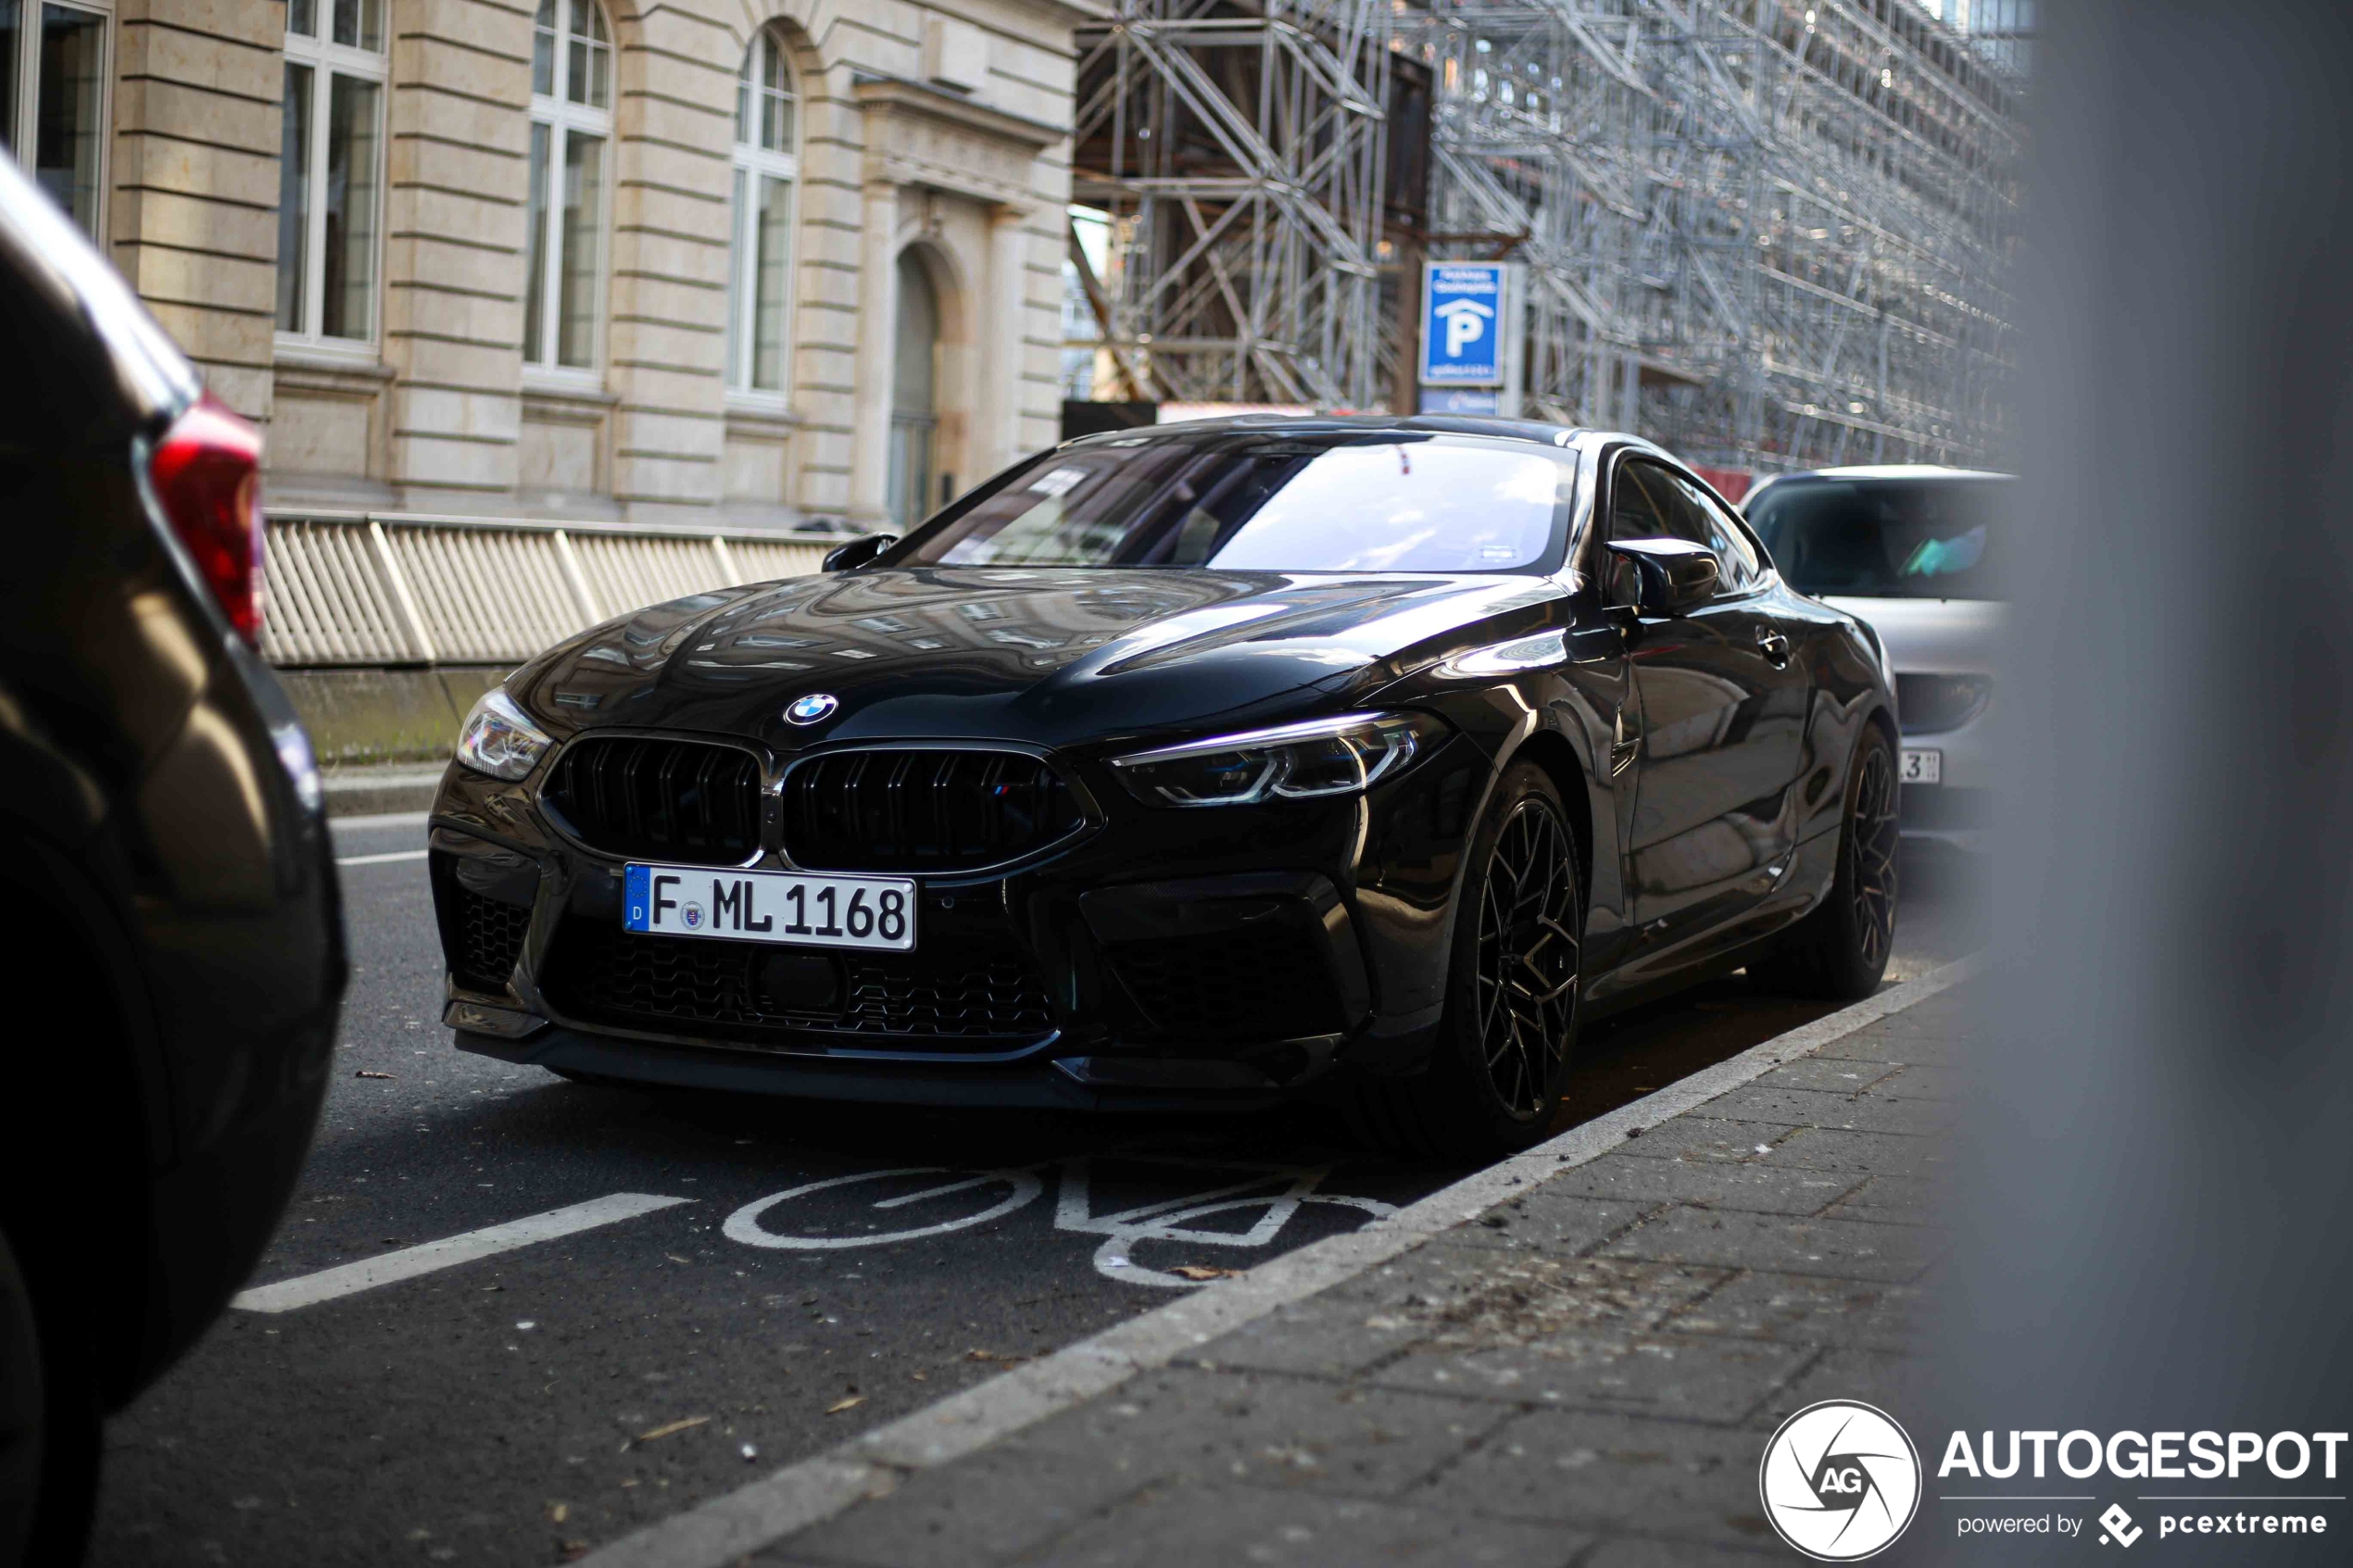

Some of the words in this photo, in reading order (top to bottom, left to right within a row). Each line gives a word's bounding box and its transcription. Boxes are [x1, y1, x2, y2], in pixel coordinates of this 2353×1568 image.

[1446, 312, 1484, 358] P
[633, 906, 642, 920] D
[653, 875, 681, 924] F
[713, 879, 773, 932] ML
[786, 884, 906, 940] 1168
